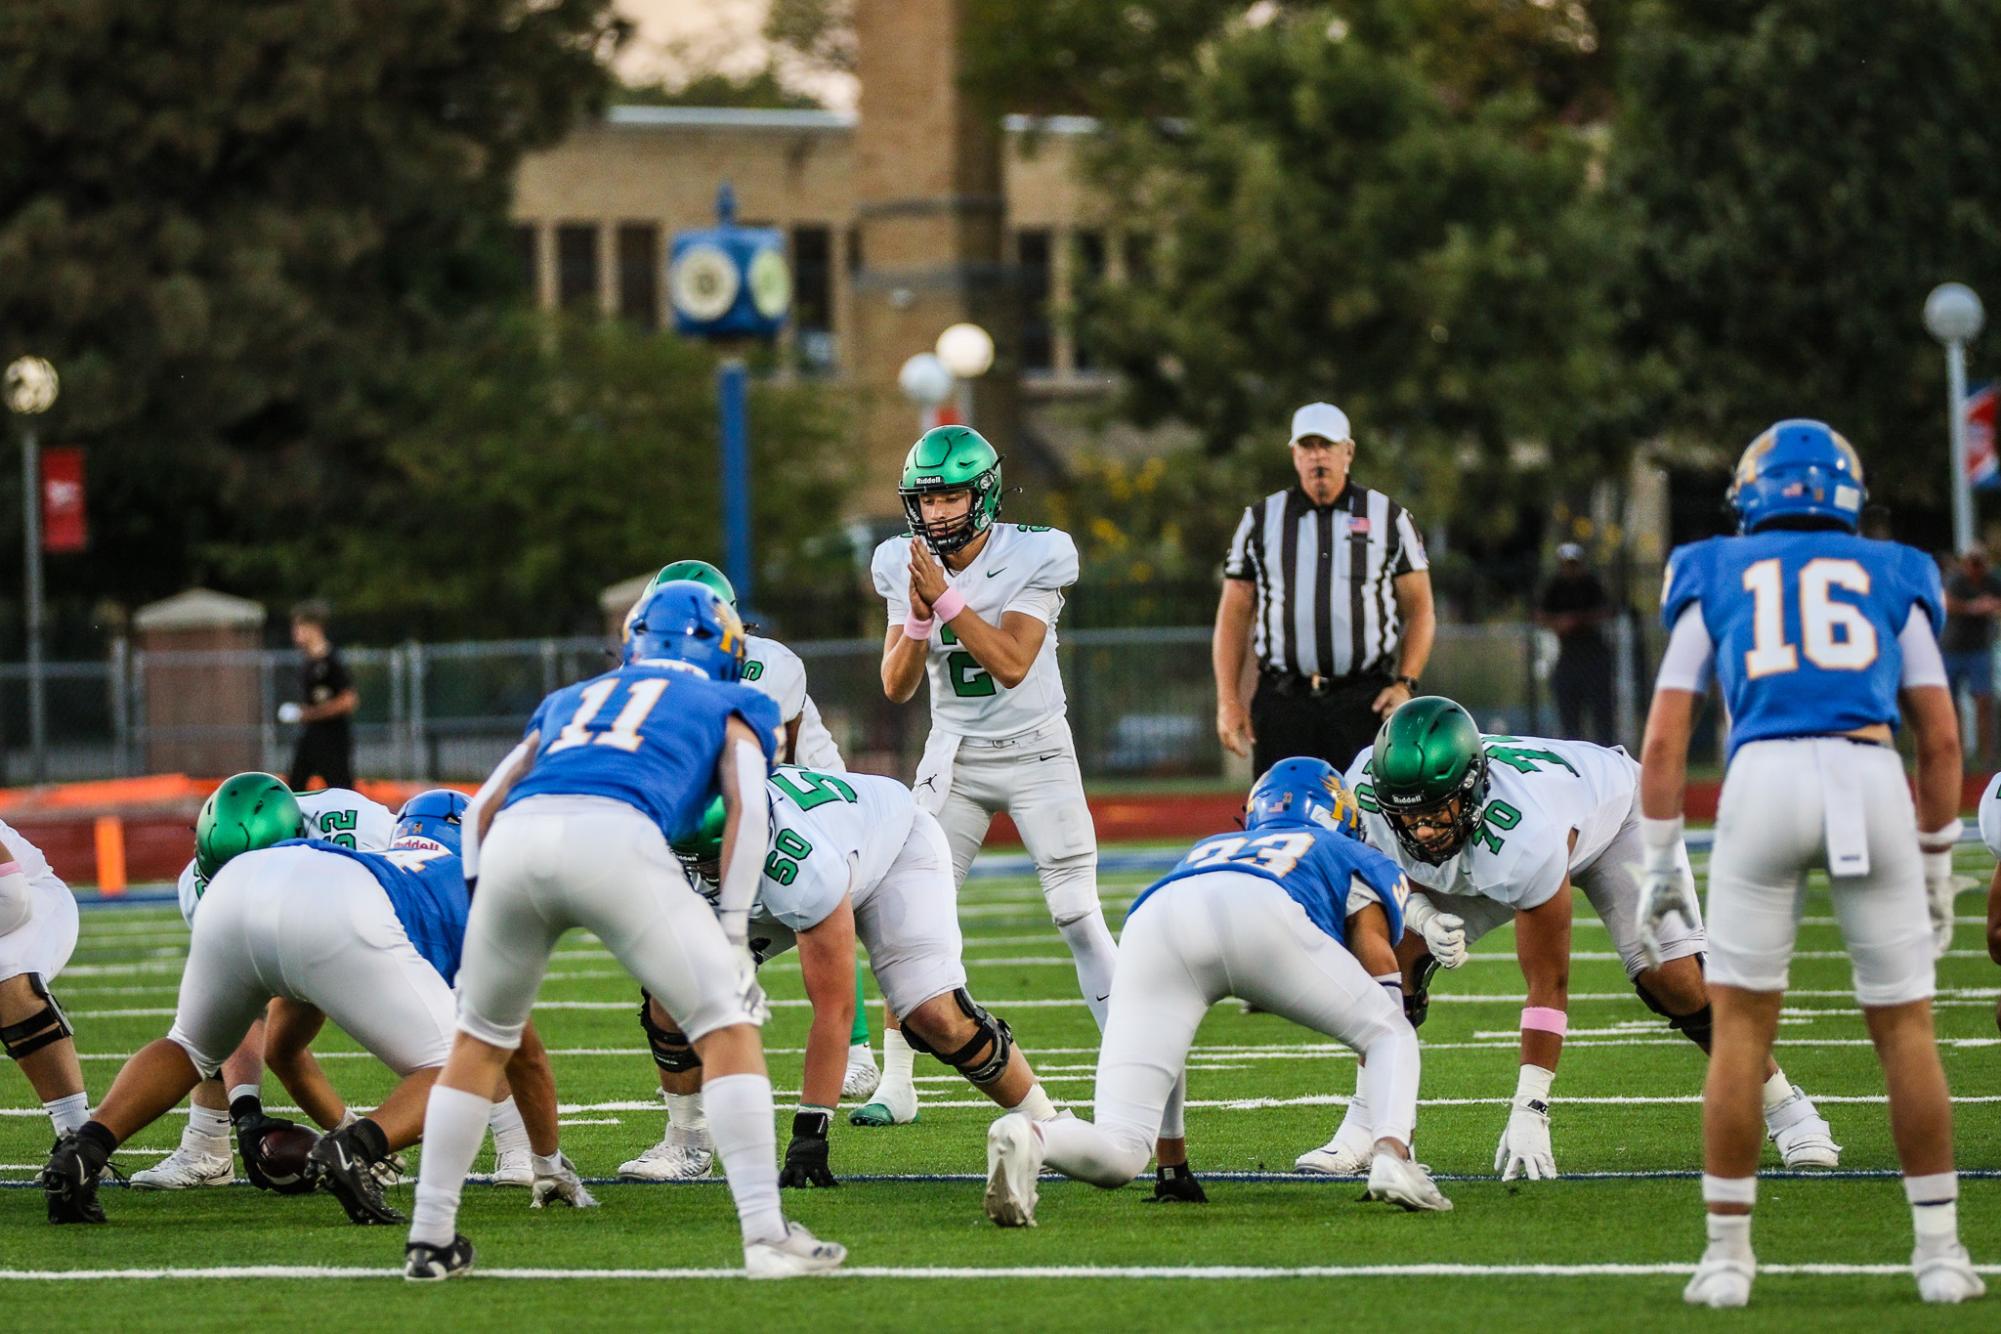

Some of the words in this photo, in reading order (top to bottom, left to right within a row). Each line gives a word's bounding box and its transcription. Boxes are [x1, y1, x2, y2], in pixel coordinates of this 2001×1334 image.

[915, 476, 941, 486] Riddell
[1743, 557, 1878, 681] 16
[545, 677, 671, 755] 11
[1391, 793, 1423, 804] Riddell
[1186, 831, 1317, 879] 23
[1471, 799, 1523, 856] 70
[763, 827, 814, 887] 50
